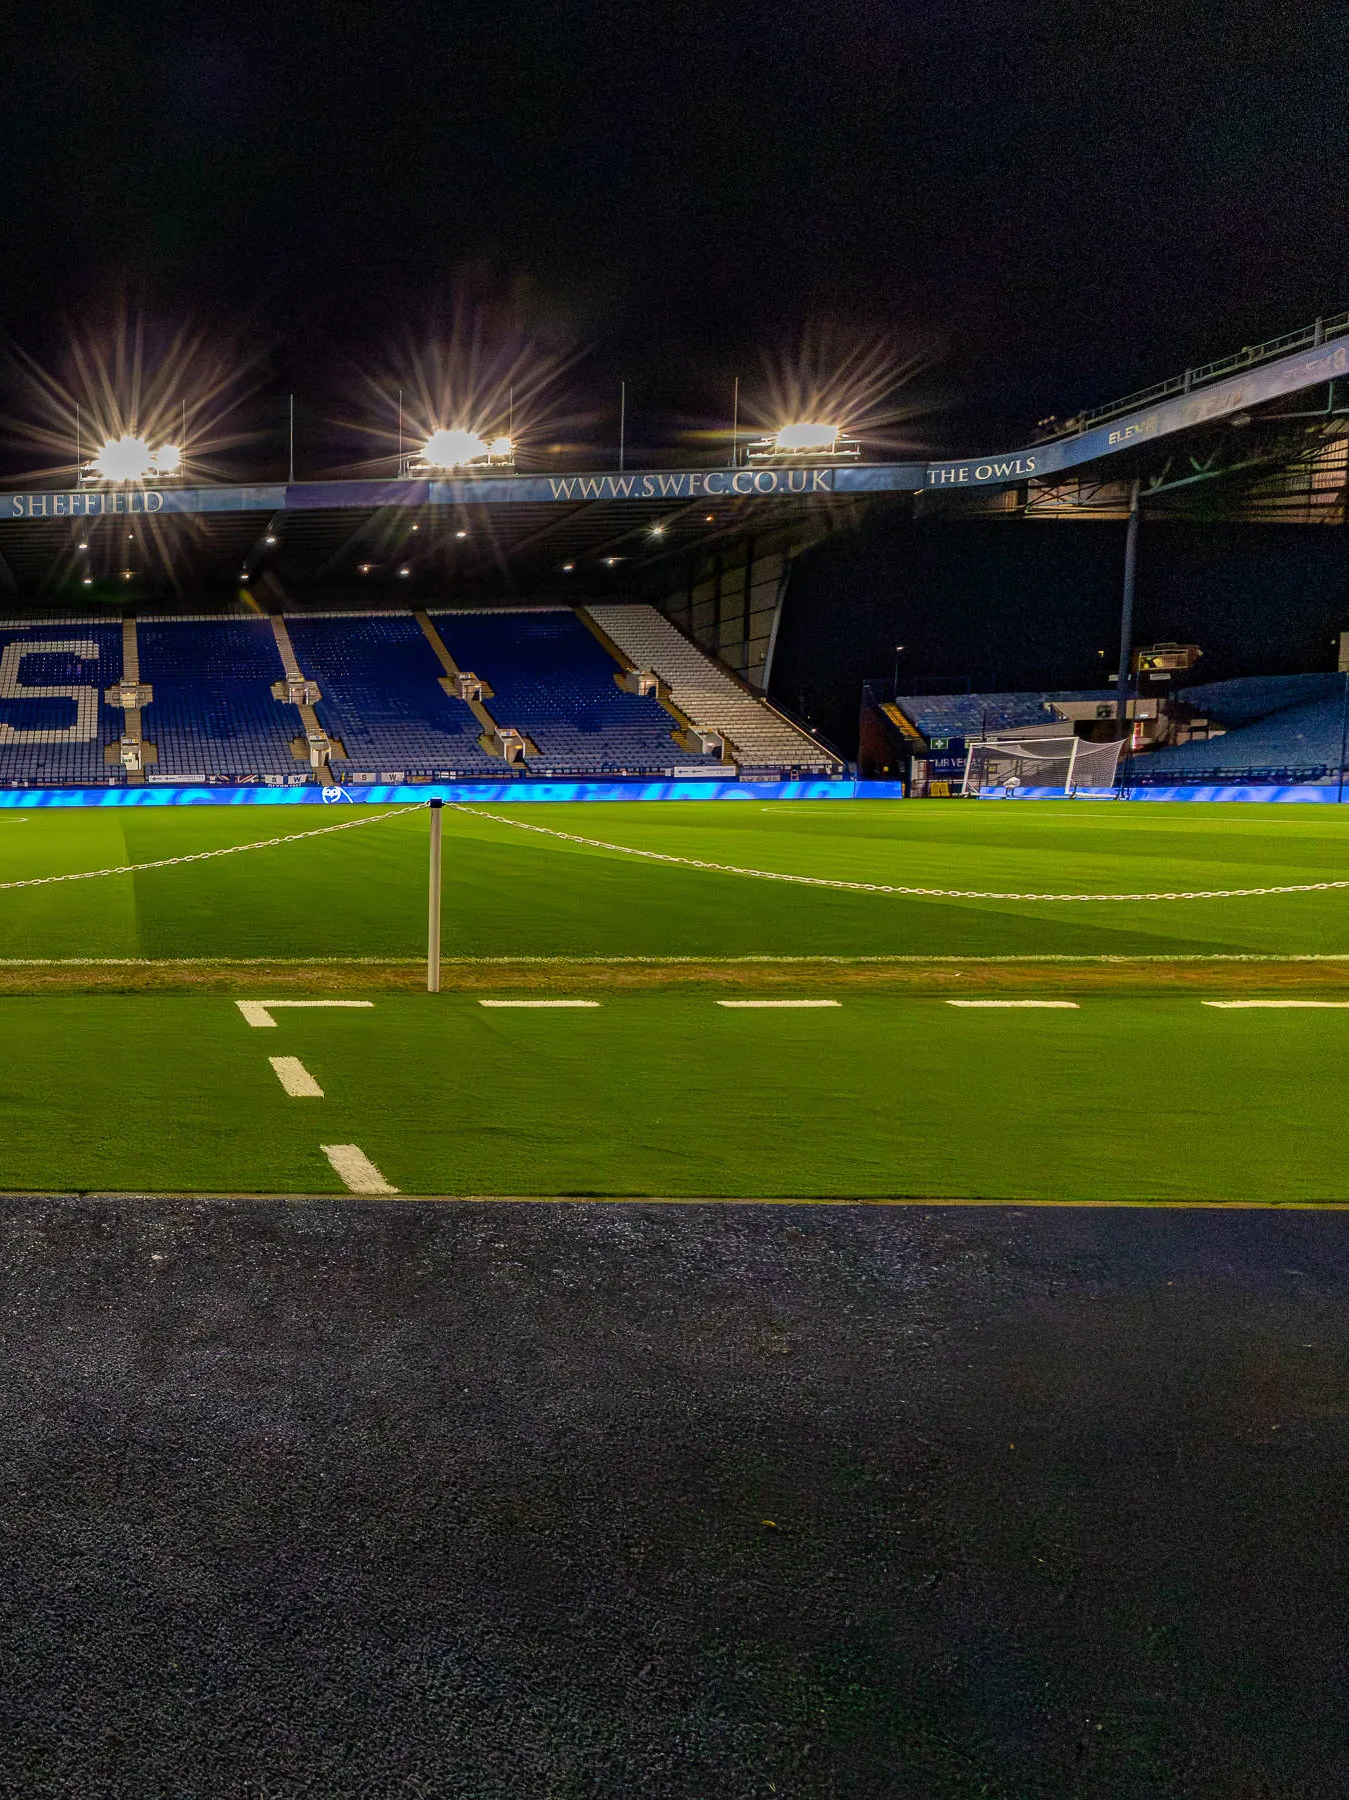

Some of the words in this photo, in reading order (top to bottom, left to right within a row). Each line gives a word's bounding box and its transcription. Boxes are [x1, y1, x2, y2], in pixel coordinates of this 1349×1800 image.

[548, 469, 832, 499] WWW.SWFC.CO.UK
[927, 468, 969, 484] THE
[975, 456, 1035, 480] OWLS
[12, 491, 164, 517] SHEFFIELD
